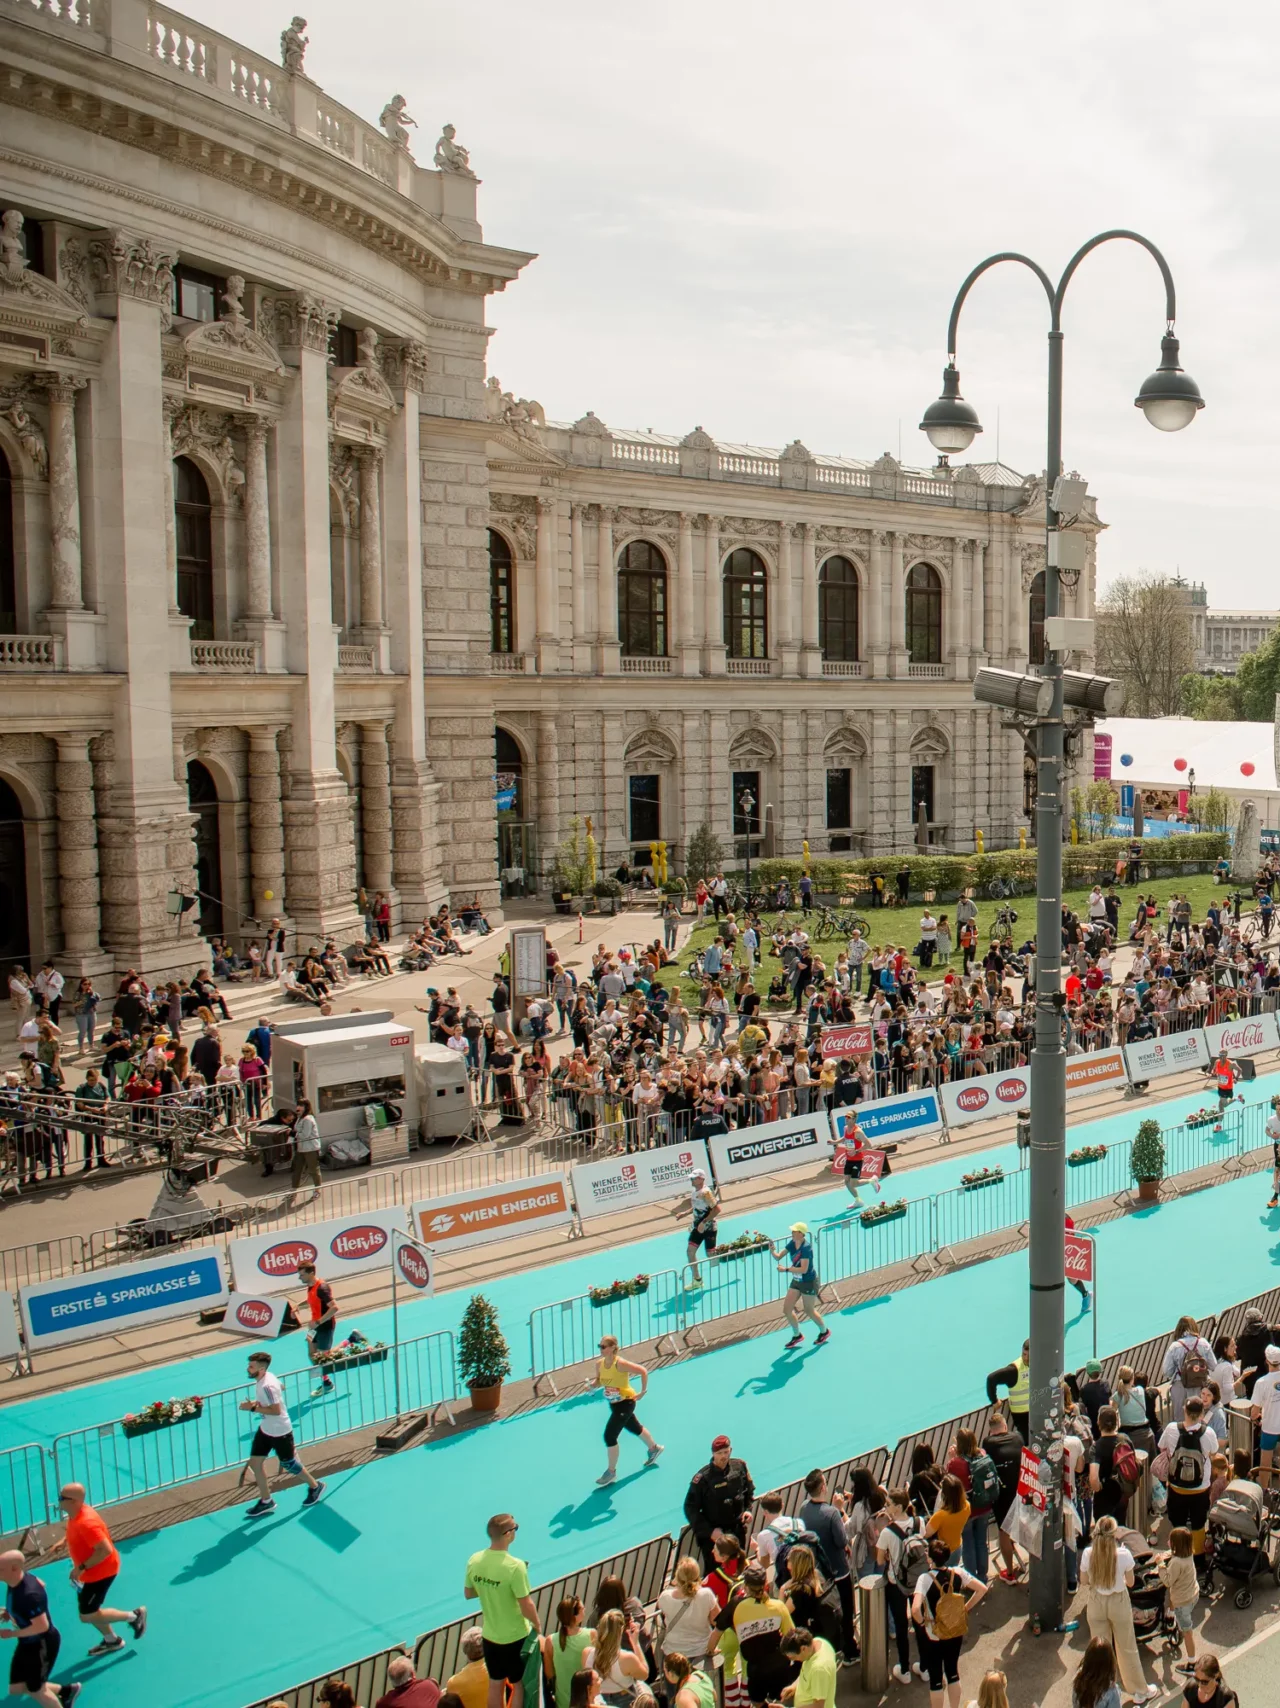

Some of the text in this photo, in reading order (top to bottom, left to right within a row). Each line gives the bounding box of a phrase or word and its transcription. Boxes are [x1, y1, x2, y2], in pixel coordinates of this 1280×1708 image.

[391, 1037, 409, 1045] ORF
[822, 1031, 870, 1053] Coca-Cola
[1221, 1022, 1264, 1051] Coca-Cola
[1088, 1061, 1121, 1077] ENERGIE
[999, 1083, 1025, 1097] Hervis
[959, 1093, 987, 1107] Hervis
[880, 1109, 920, 1125] SPARKASSE
[650, 1162, 680, 1175] WIENER
[592, 1175, 623, 1188] WIENER
[460, 1192, 559, 1224] WIEN ENERGIE
[336, 1232, 384, 1253] Hervis
[263, 1247, 314, 1269] Hervis
[401, 1249, 428, 1281] Hervis
[51, 1277, 188, 1318] ERSTE SPARKASSE
[239, 1304, 270, 1322] Hervis
